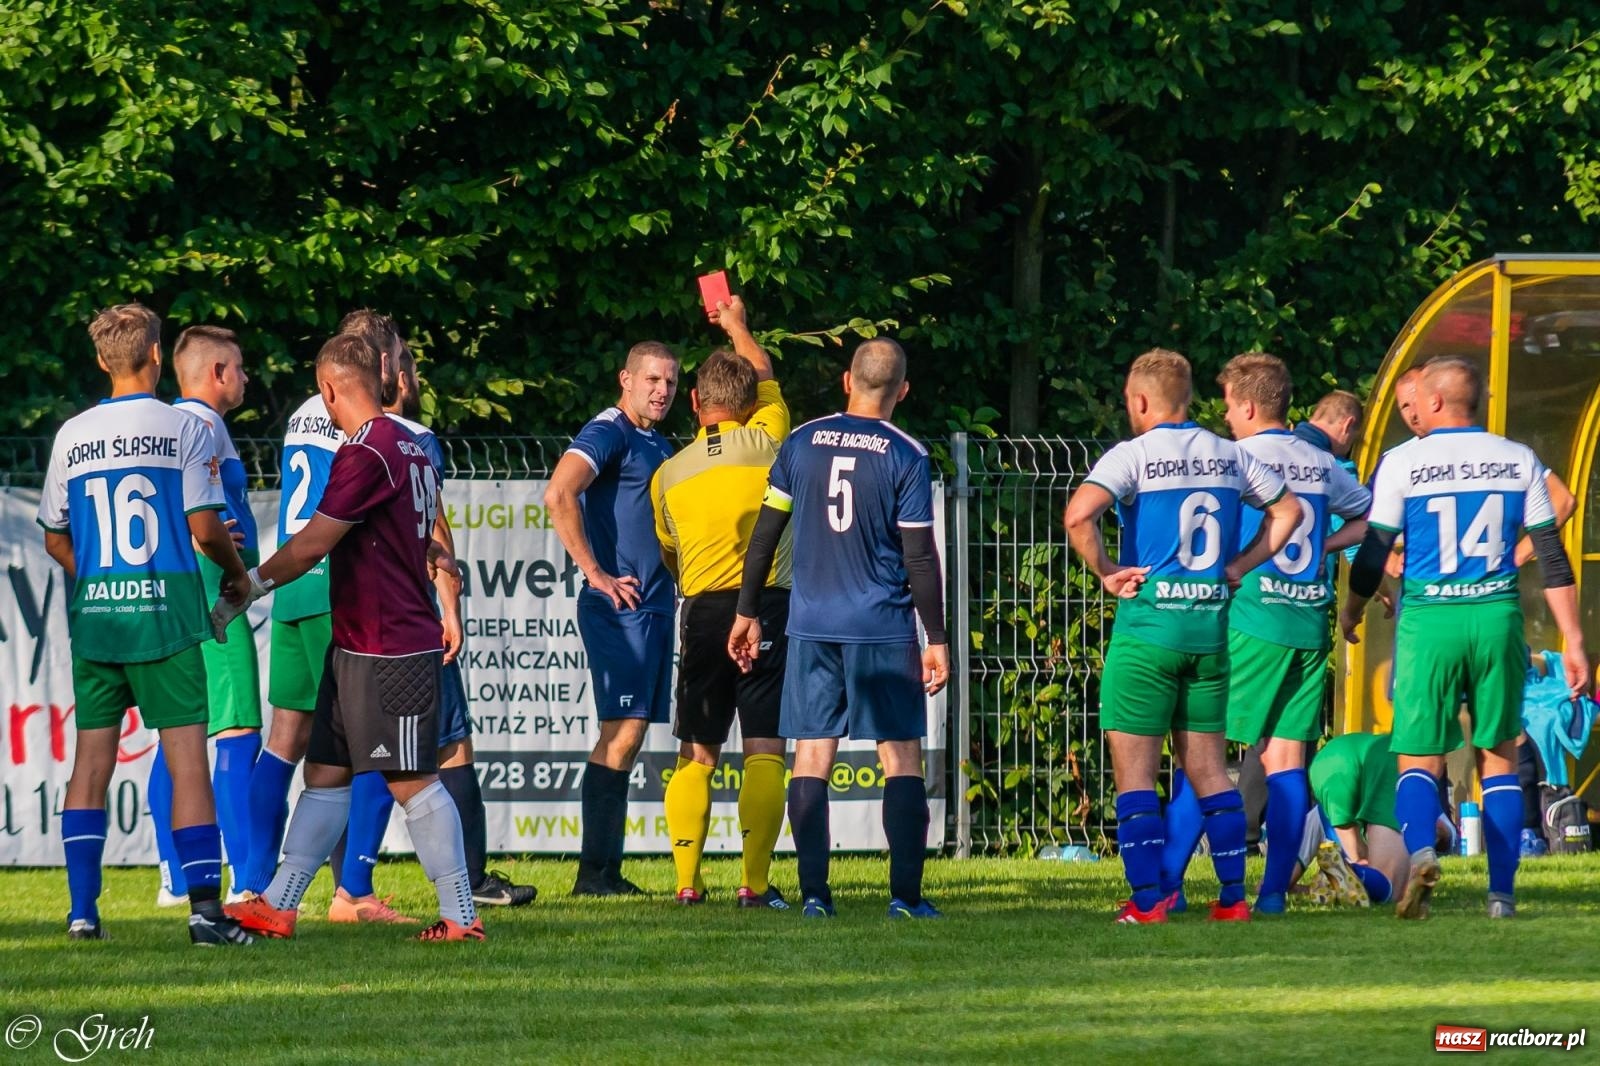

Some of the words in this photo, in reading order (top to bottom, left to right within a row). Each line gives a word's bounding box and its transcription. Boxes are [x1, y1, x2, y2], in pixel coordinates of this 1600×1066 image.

[812, 430, 841, 446] OCICE
[840, 433, 890, 454] RACIBÓRZ
[285, 449, 312, 535] 2
[827, 456, 856, 532] 5
[85, 473, 159, 568] 16
[447, 503, 515, 529] ŁUGI
[1178, 491, 1221, 572] 6
[1426, 493, 1506, 575] 14
[464, 618, 578, 637] CIEPLENIA
[467, 683, 570, 702] LOWANIE
[470, 711, 528, 735] NTAŻ
[534, 716, 589, 735] PŁYT
[474, 761, 525, 790] 728
[532, 761, 587, 790] 877
